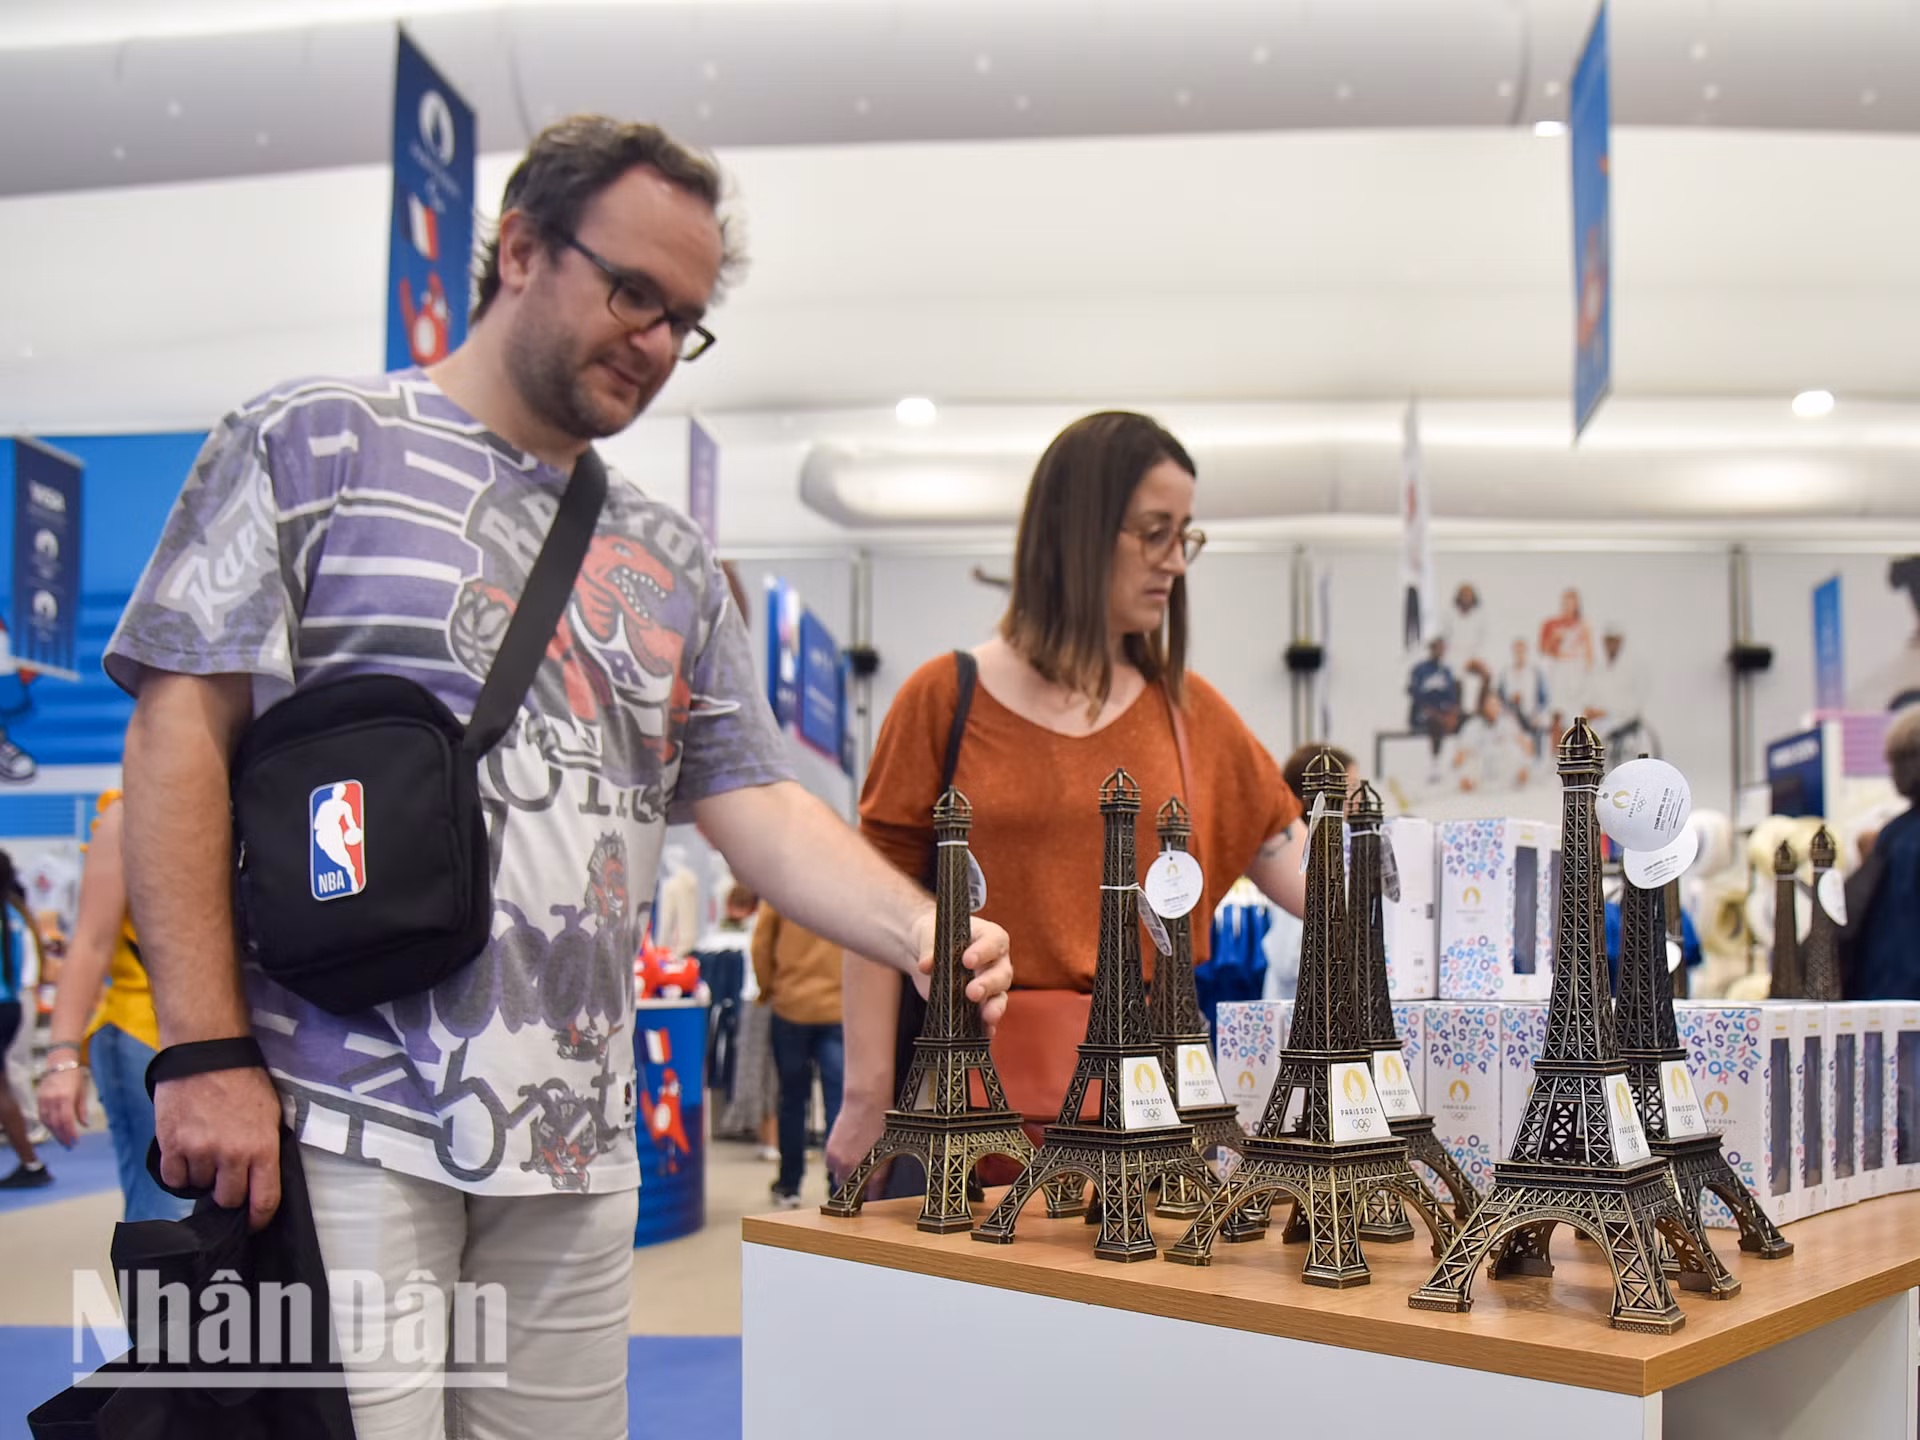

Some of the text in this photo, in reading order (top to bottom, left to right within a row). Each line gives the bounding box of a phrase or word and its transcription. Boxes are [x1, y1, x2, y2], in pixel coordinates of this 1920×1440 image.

[318, 869, 346, 894] NBA
[1151, 1097, 1167, 1105] 2024
[1341, 1106, 1377, 1116] PARIS 2024
